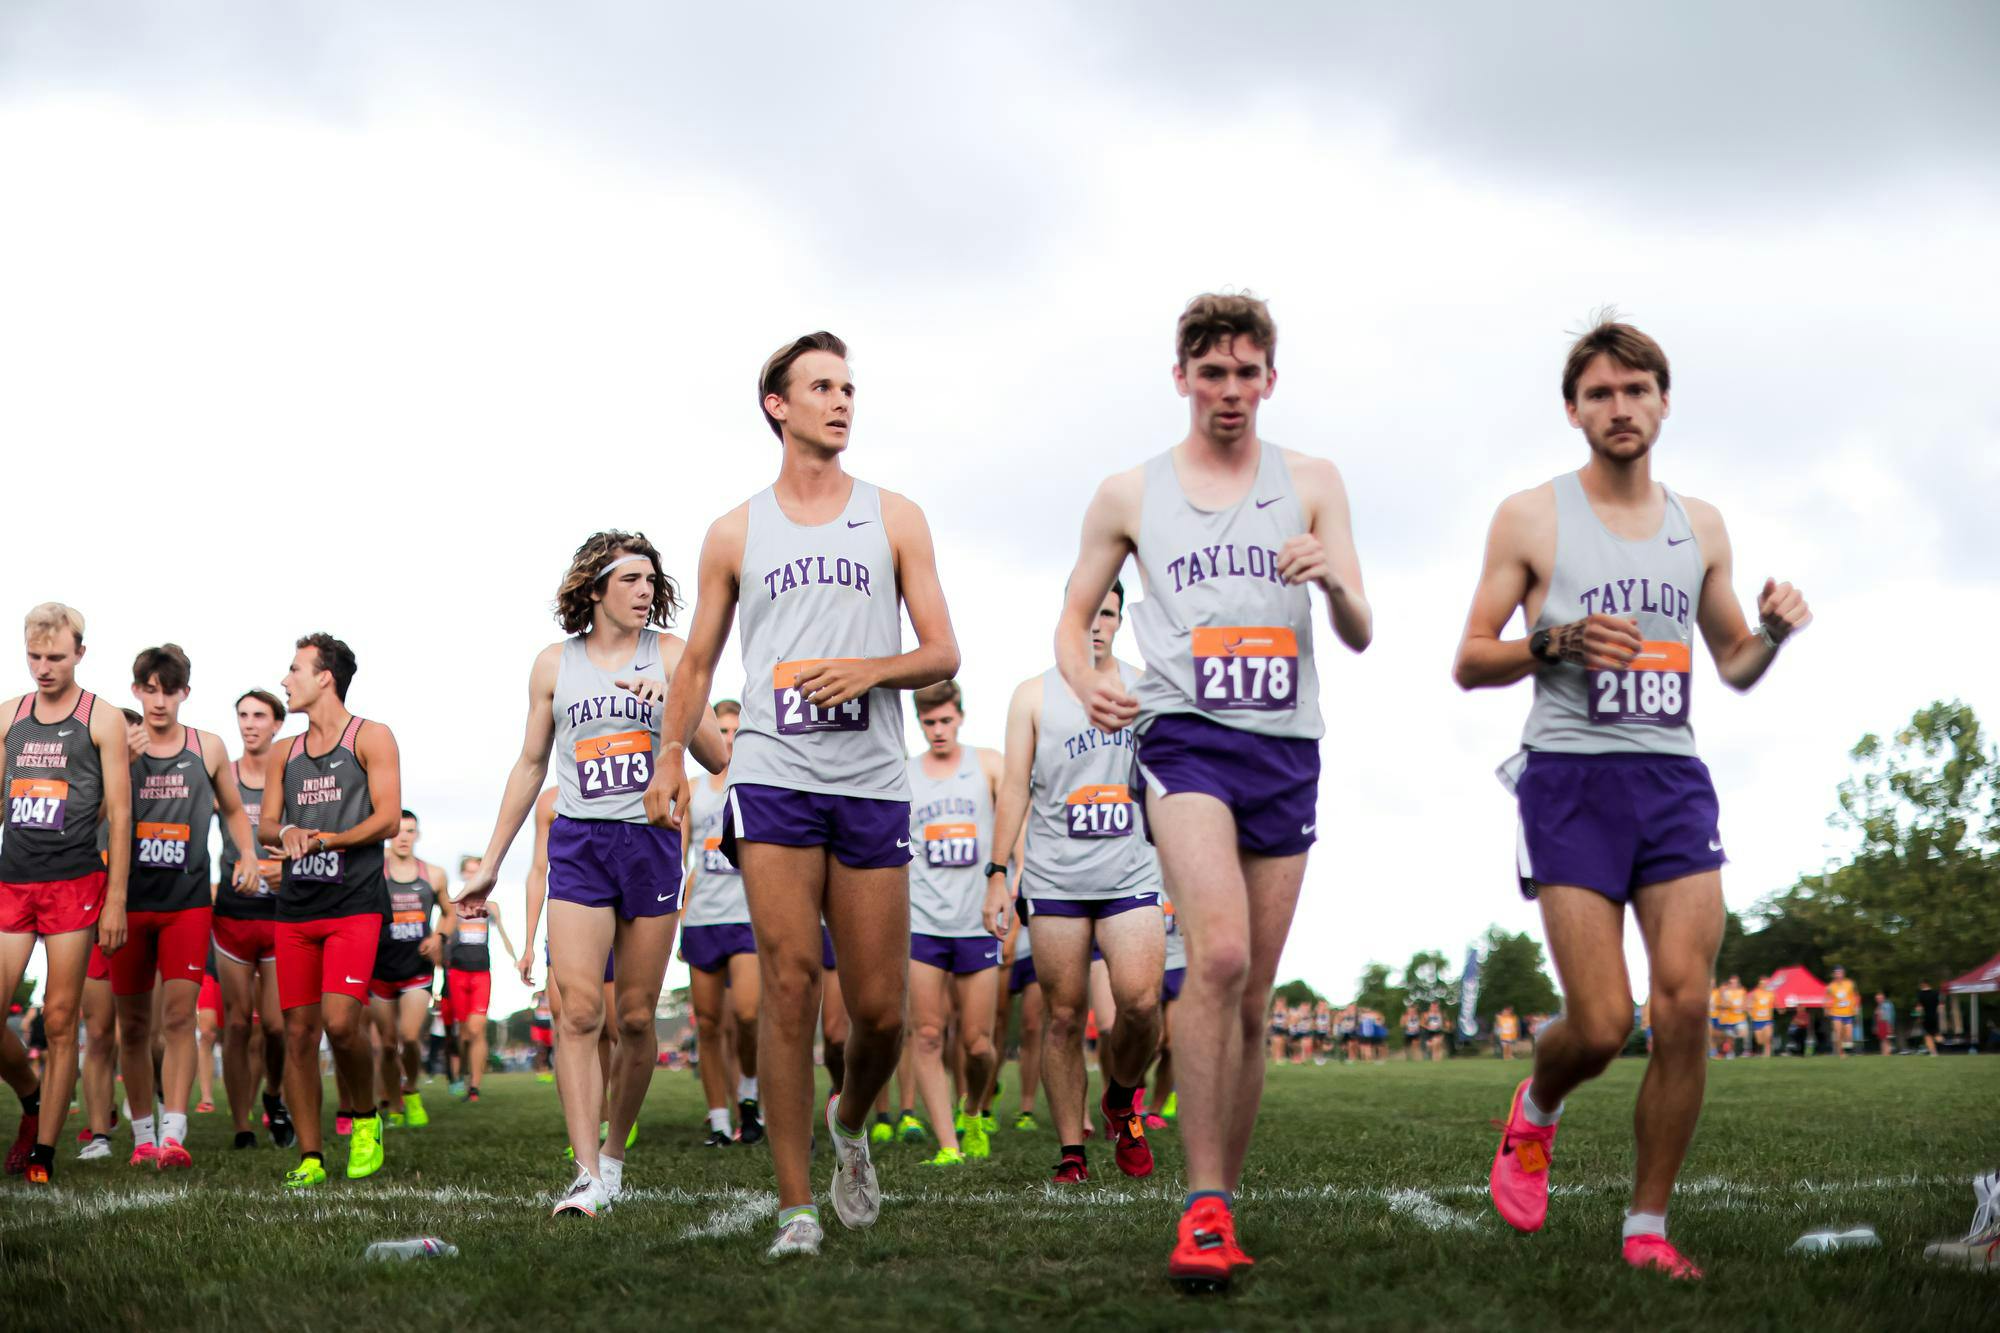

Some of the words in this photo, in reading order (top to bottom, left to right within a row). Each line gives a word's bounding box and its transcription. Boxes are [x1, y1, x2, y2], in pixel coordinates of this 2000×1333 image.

[764, 556, 871, 600] TAYLOR
[1167, 544, 1287, 593] TAYLOR
[1580, 578, 1689, 626] TAYLOR
[1203, 657, 1290, 700] 2178
[1597, 671, 1682, 715] 2188
[567, 696, 653, 728] TAYLOR
[22, 742, 63, 755] INDIANA
[1064, 728, 1134, 759] TAYLOR
[16, 755, 67, 768] WESLEYAN
[584, 752, 649, 791] 2173
[297, 788, 342, 805] WESEYAN
[303, 776, 336, 792] INDANA
[11, 797, 60, 824] 2047
[1072, 804, 1128, 831] 2170
[139, 838, 186, 864] 2065
[292, 851, 340, 877] 2063
[928, 839, 974, 863] 2177
